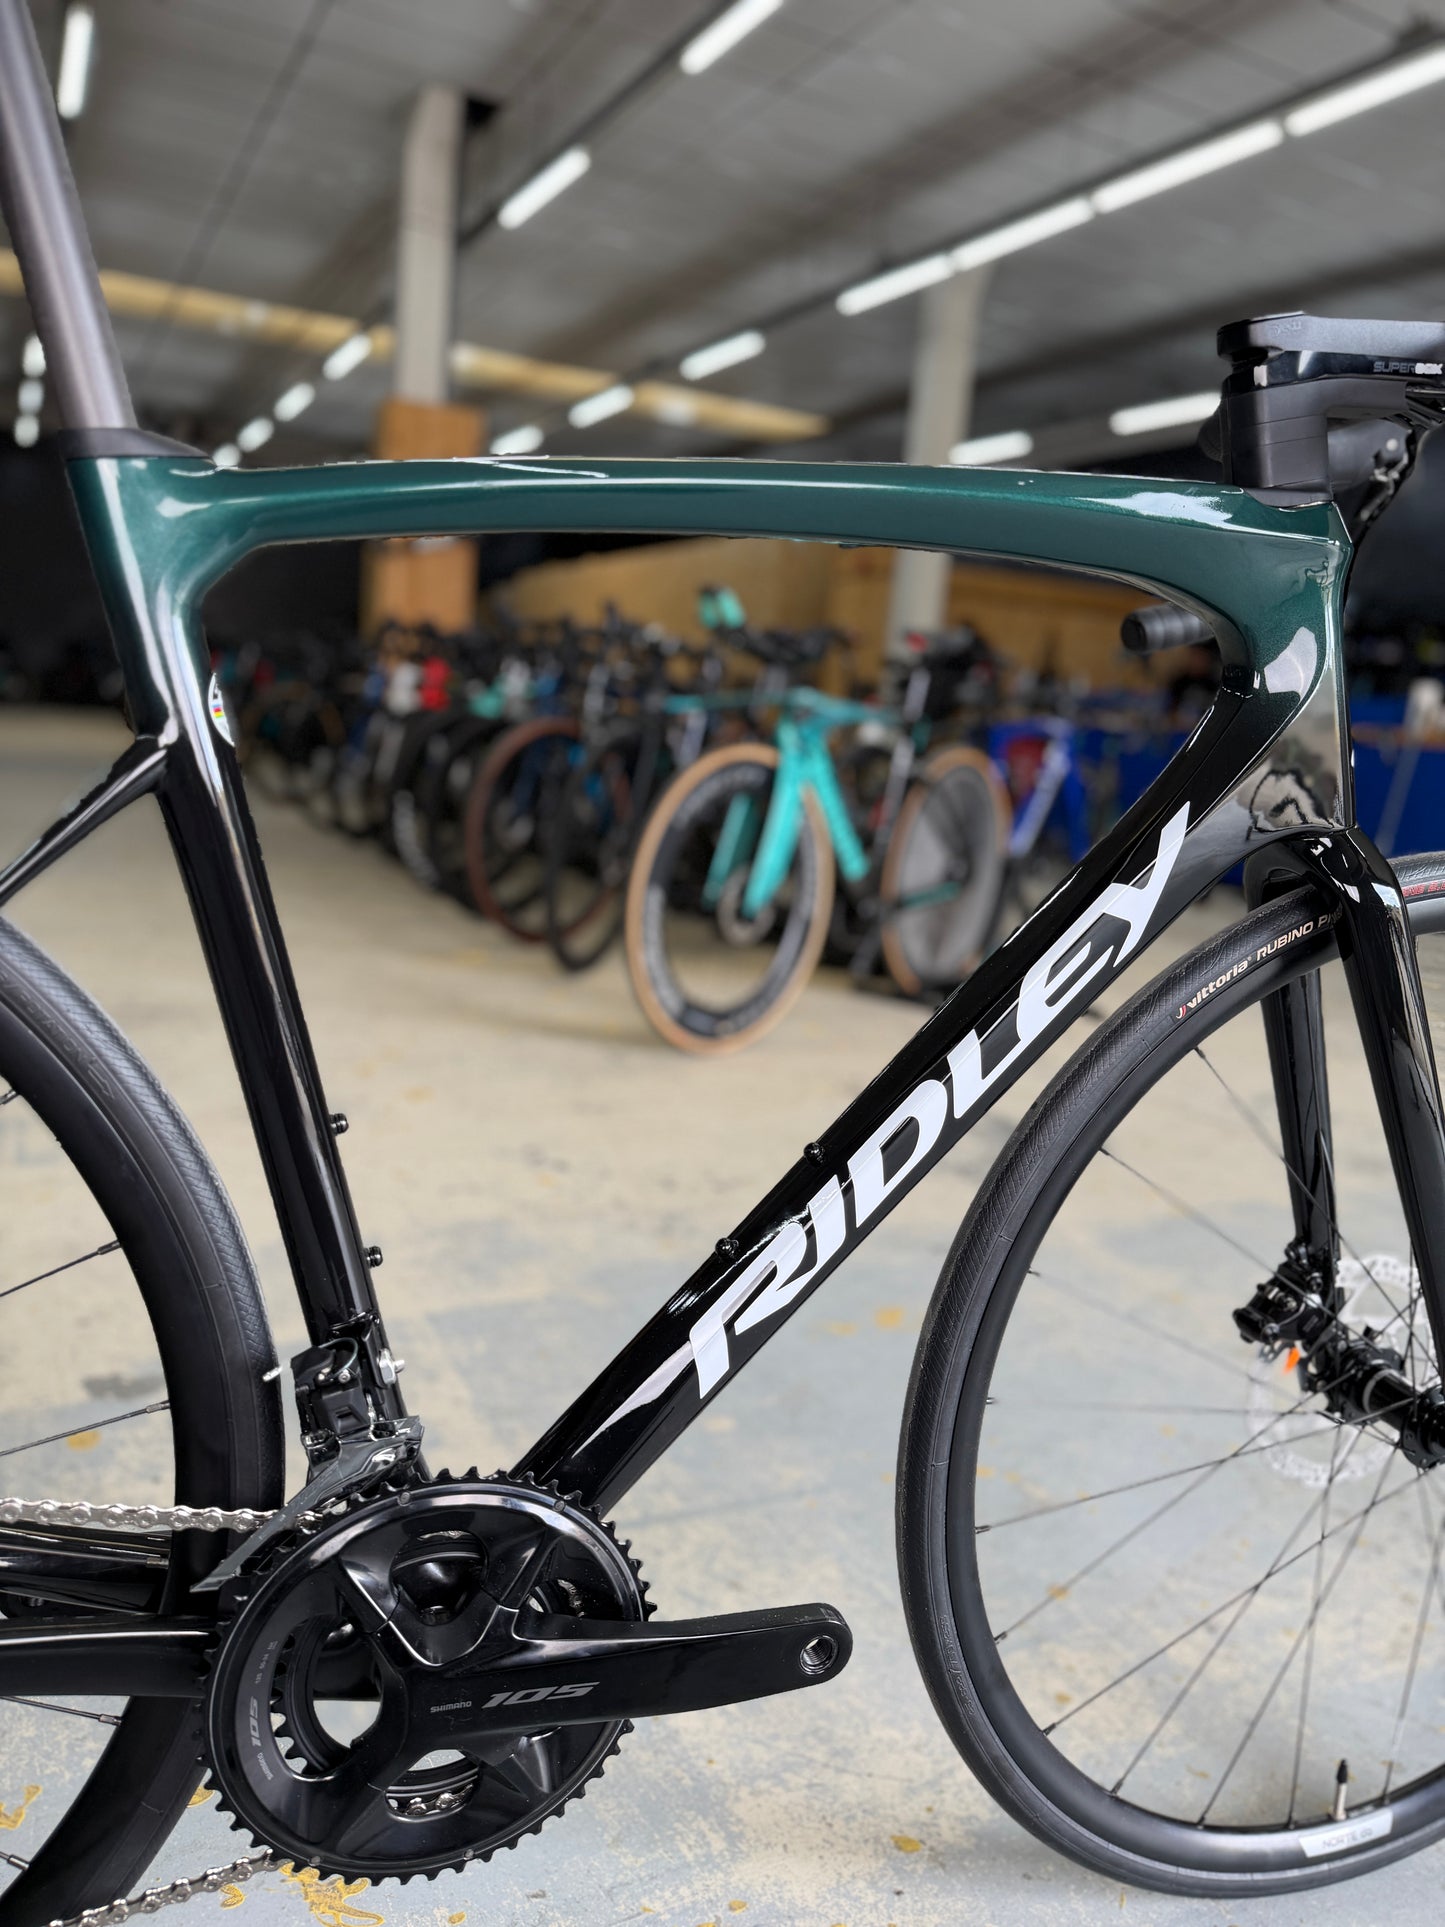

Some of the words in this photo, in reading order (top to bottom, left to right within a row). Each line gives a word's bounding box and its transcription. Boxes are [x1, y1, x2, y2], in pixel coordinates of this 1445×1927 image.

[1186, 959, 1249, 1009] vittoria
[1256, 921, 1314, 961] RUBINO
[689, 801, 1190, 1399] RIDLEY
[249, 1696, 262, 1747] 105
[430, 1701, 472, 1713] SHIMANO
[481, 1681, 600, 1709] 105
